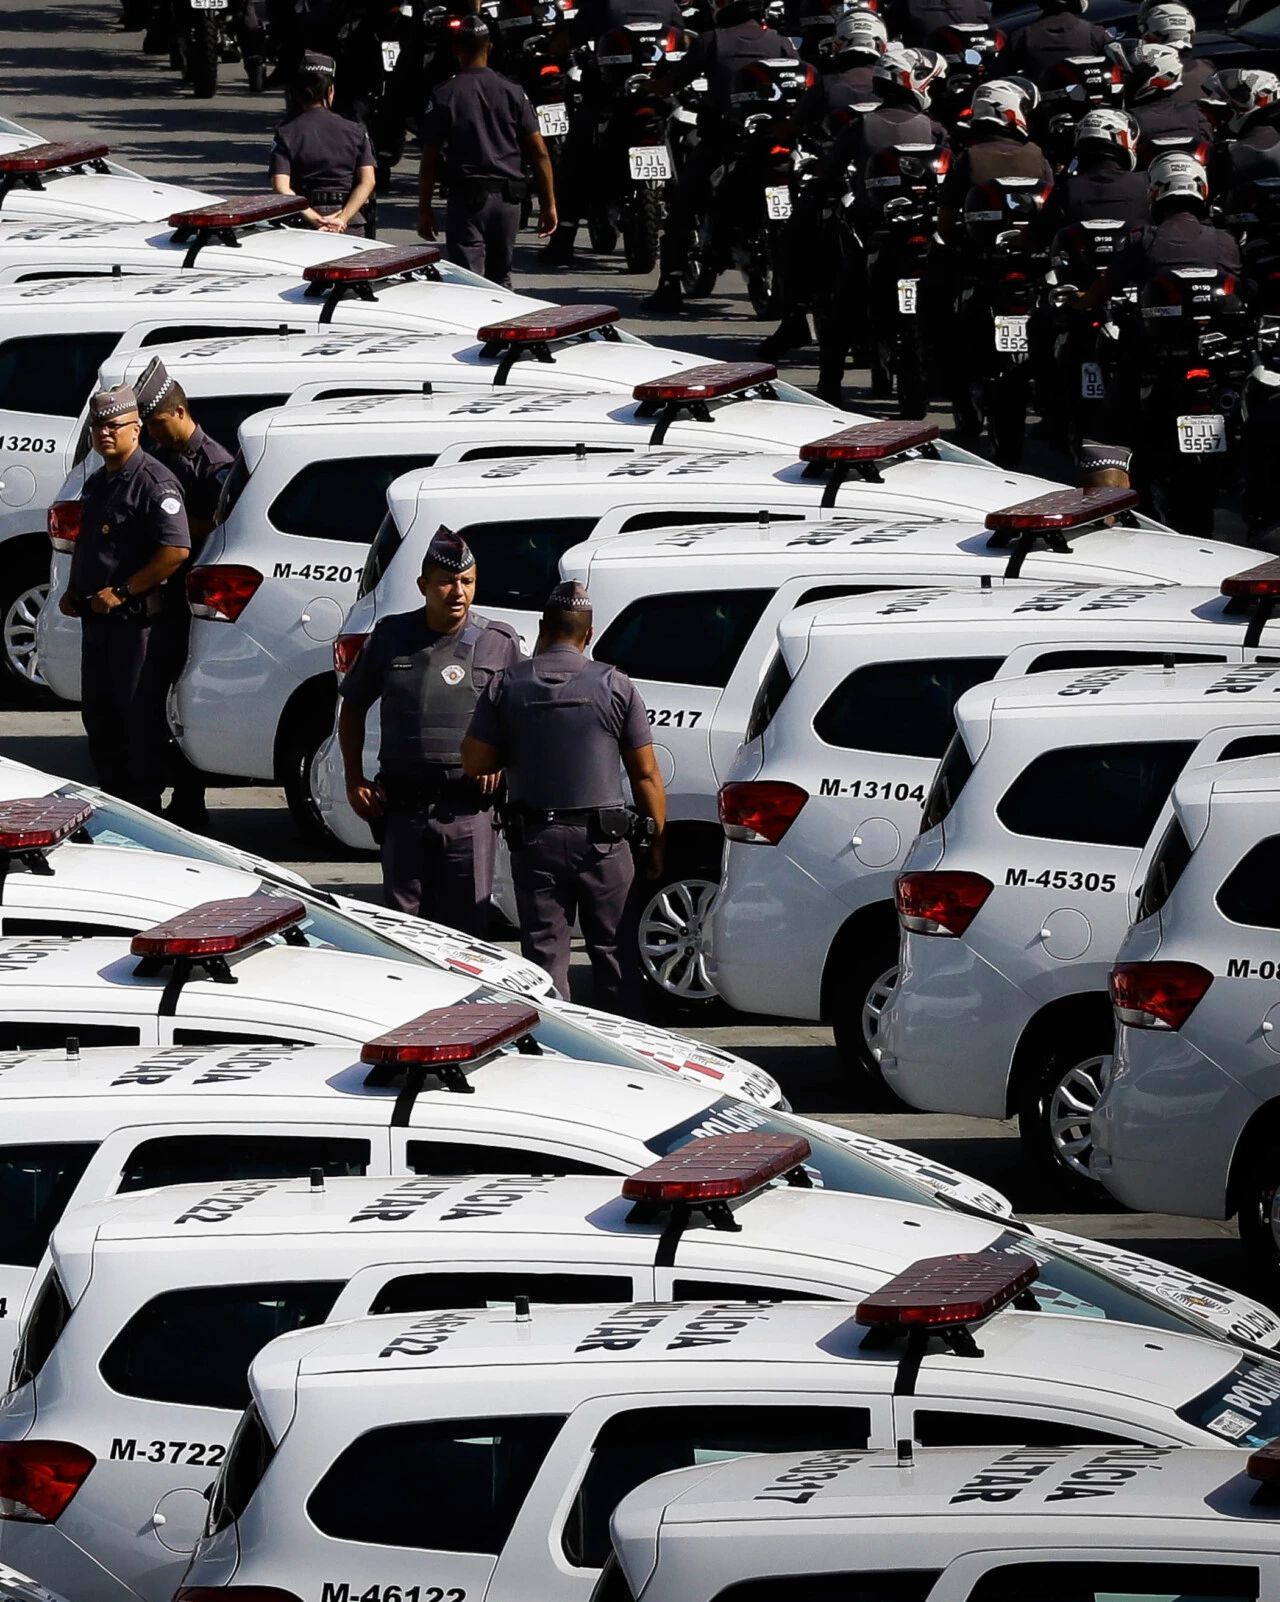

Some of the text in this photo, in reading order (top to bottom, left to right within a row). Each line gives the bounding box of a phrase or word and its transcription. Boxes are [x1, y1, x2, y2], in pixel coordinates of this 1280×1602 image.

[545, 123, 567, 134] 178
[635, 154, 665, 167] DJL
[1001, 324, 1023, 337] DJ
[1000, 337, 1028, 350] 952
[1184, 425, 1220, 438] DJL
[1184, 438, 1221, 451] 9557
[273, 563, 363, 583] M-45201
[646, 709, 702, 729] 3217
[819, 778, 925, 802] M-13104
[1005, 868, 1116, 893] M-45305
[439, 1175, 556, 1221] OLÍCIA
[666, 1299, 782, 1350] OLÍCIA
[1229, 1309, 1279, 1342] OLÍCIA
[109, 1438, 224, 1467] M-3722
[1044, 1445, 1181, 1503] OLÍCIA
[321, 1582, 467, 1602] M-46122
